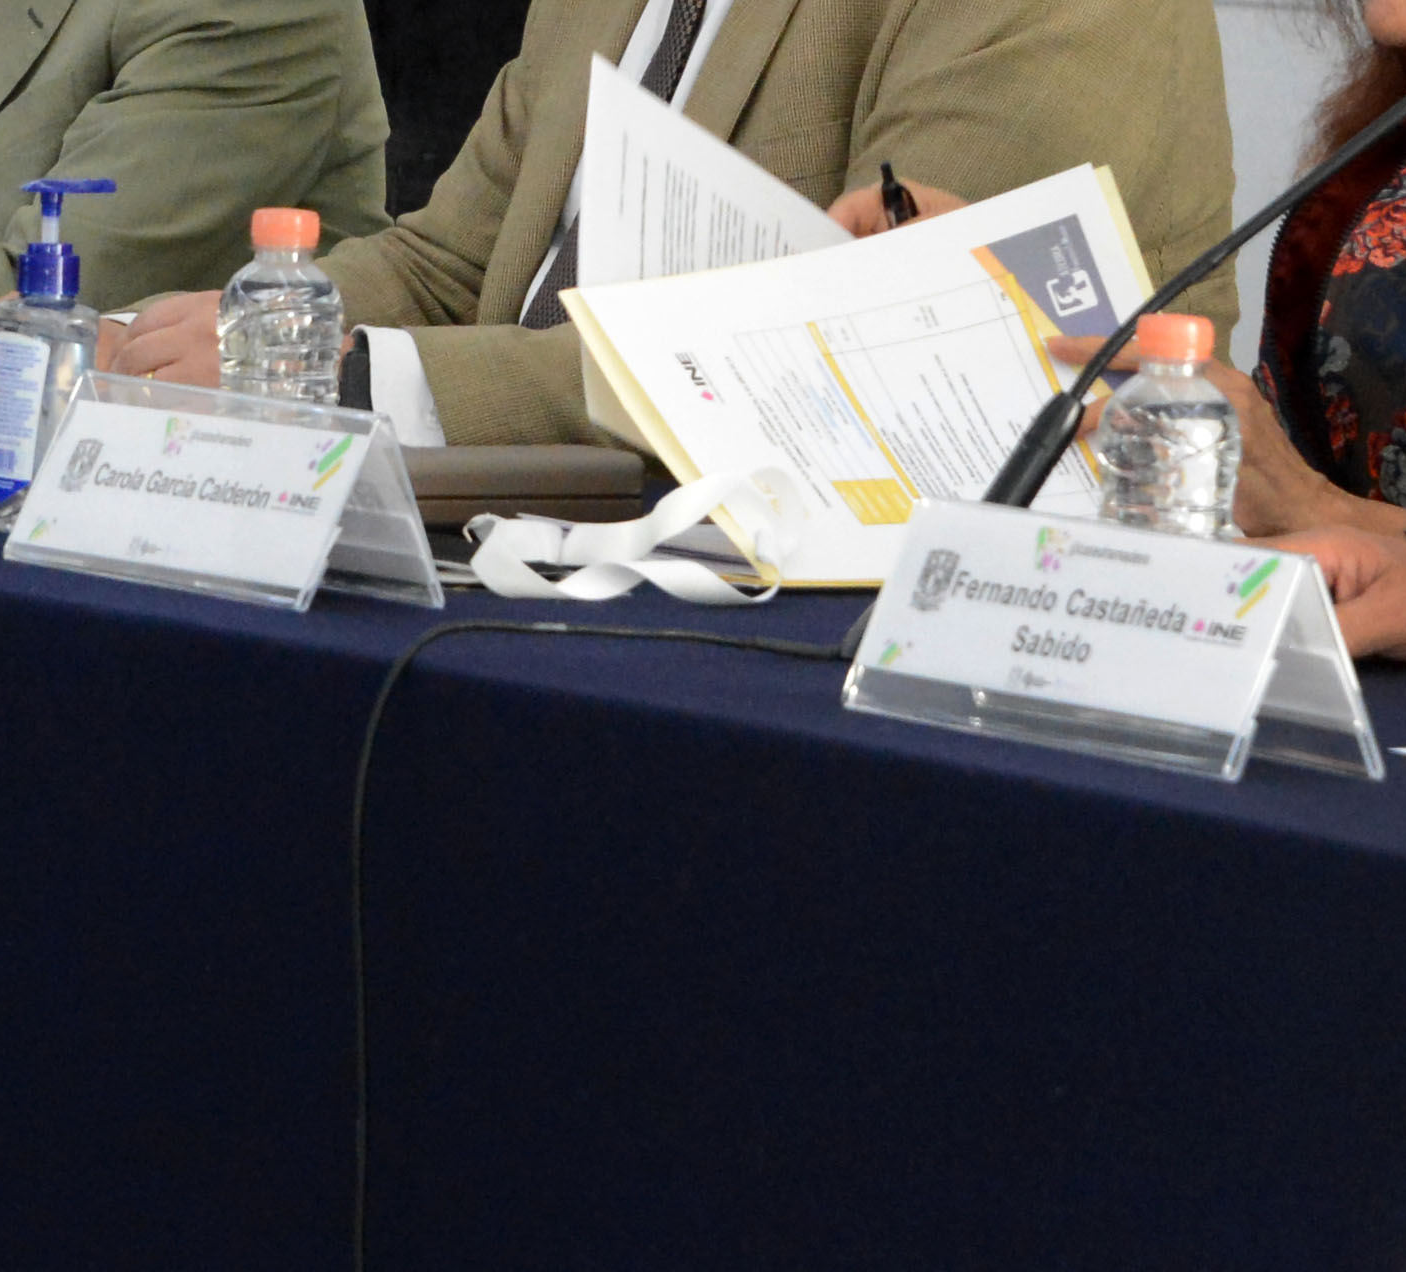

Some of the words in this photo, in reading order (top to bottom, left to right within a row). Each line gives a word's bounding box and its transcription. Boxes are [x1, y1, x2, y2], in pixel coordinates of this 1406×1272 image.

[93, 463, 142, 492] Carola
[146, 469, 197, 499] García
[198, 476, 271, 509] Calderón
[289, 491, 322, 511] INE
[951, 571, 1058, 613] Fernando
[1065, 589, 1189, 635] Castañeda
[1011, 625, 1091, 664] Sabido
[1207, 620, 1248, 641] INE
